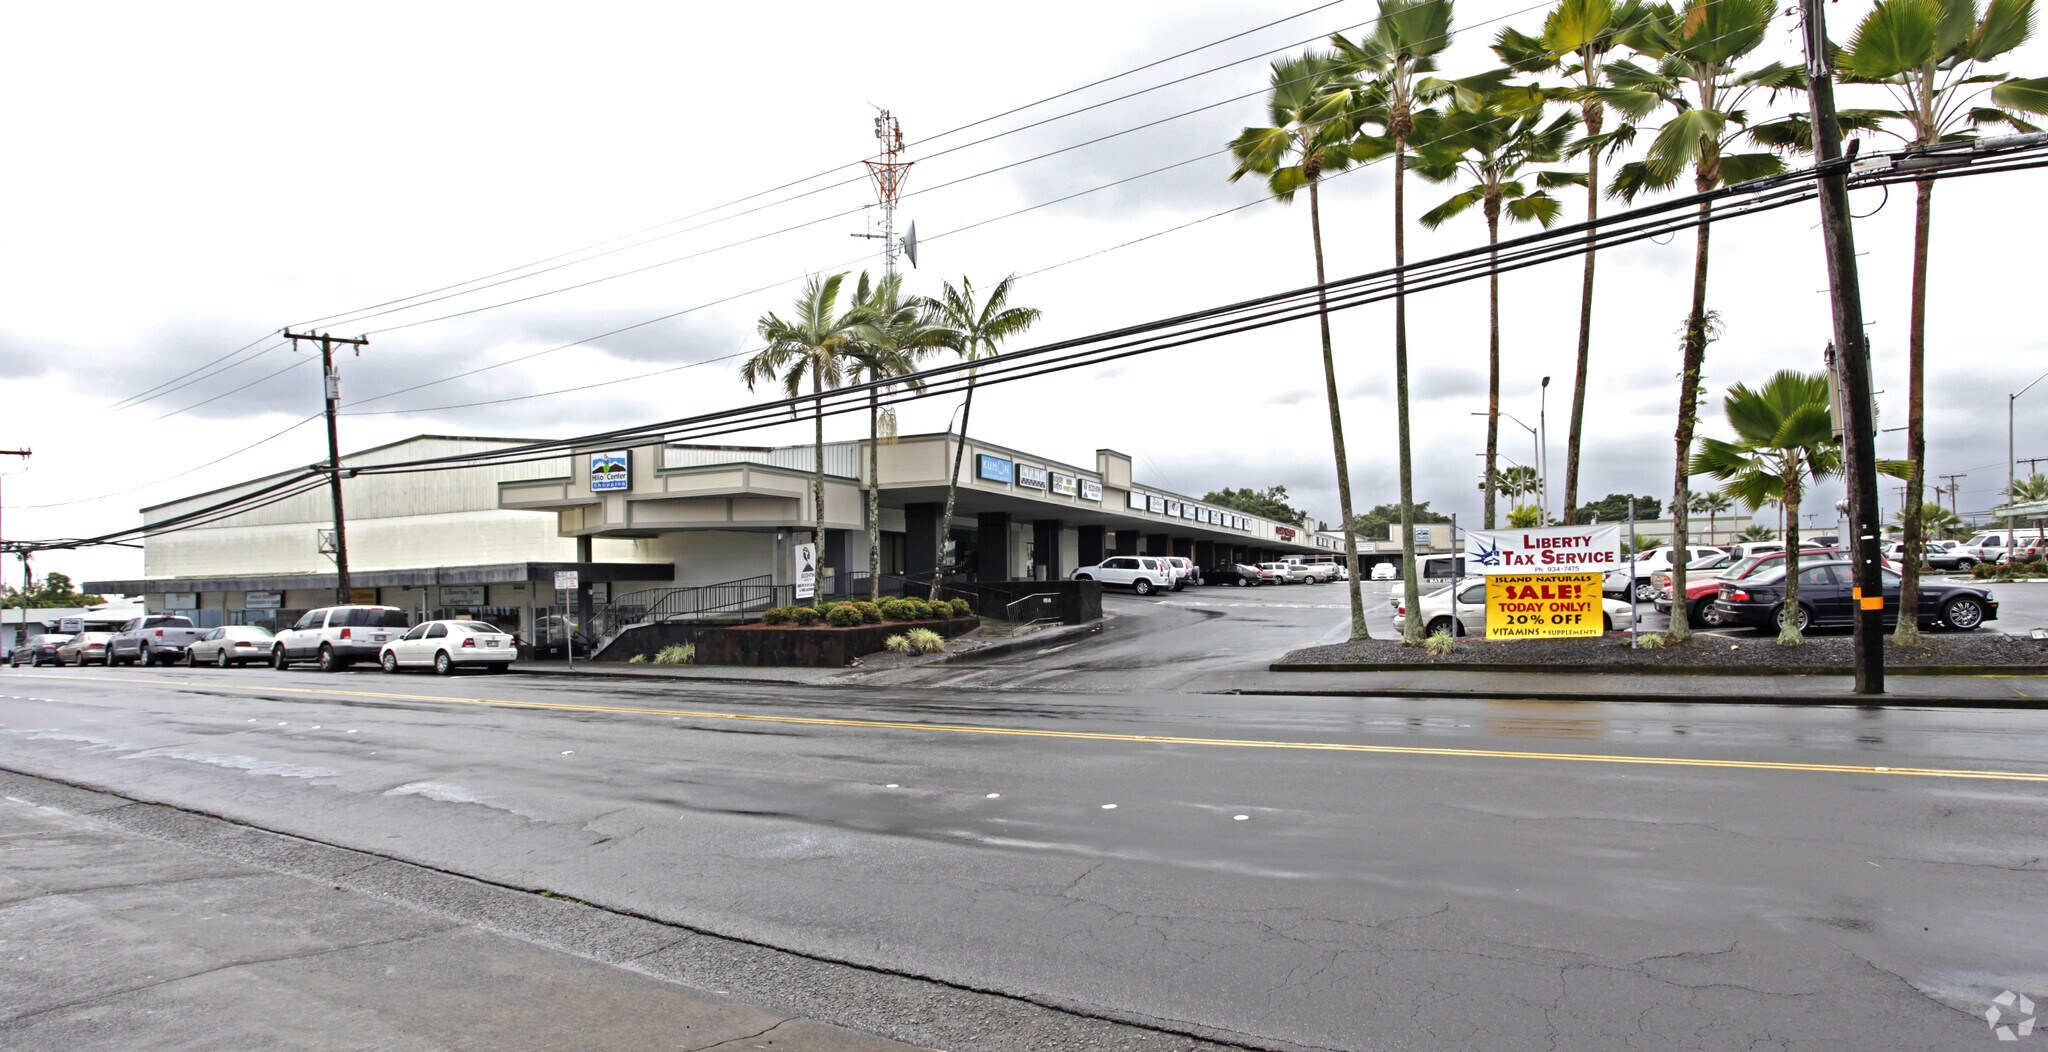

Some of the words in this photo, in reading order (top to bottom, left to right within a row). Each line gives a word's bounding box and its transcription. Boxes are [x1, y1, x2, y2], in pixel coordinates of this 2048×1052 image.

[983, 460, 1009, 475] KUMON
[1523, 534, 1592, 550] LIBERTY
[1503, 551, 1535, 566] TAX
[1541, 549, 1614, 565] SERVICE
[444, 588, 467, 597] Liberty
[1505, 584, 1582, 600] SALE!
[1498, 602, 1544, 613] TODAY
[1549, 602, 1591, 612] ONLY!
[1506, 614, 1545, 625] 20%
[1551, 614, 1582, 625] OFF
[1492, 628, 1540, 636] VITAMINS
